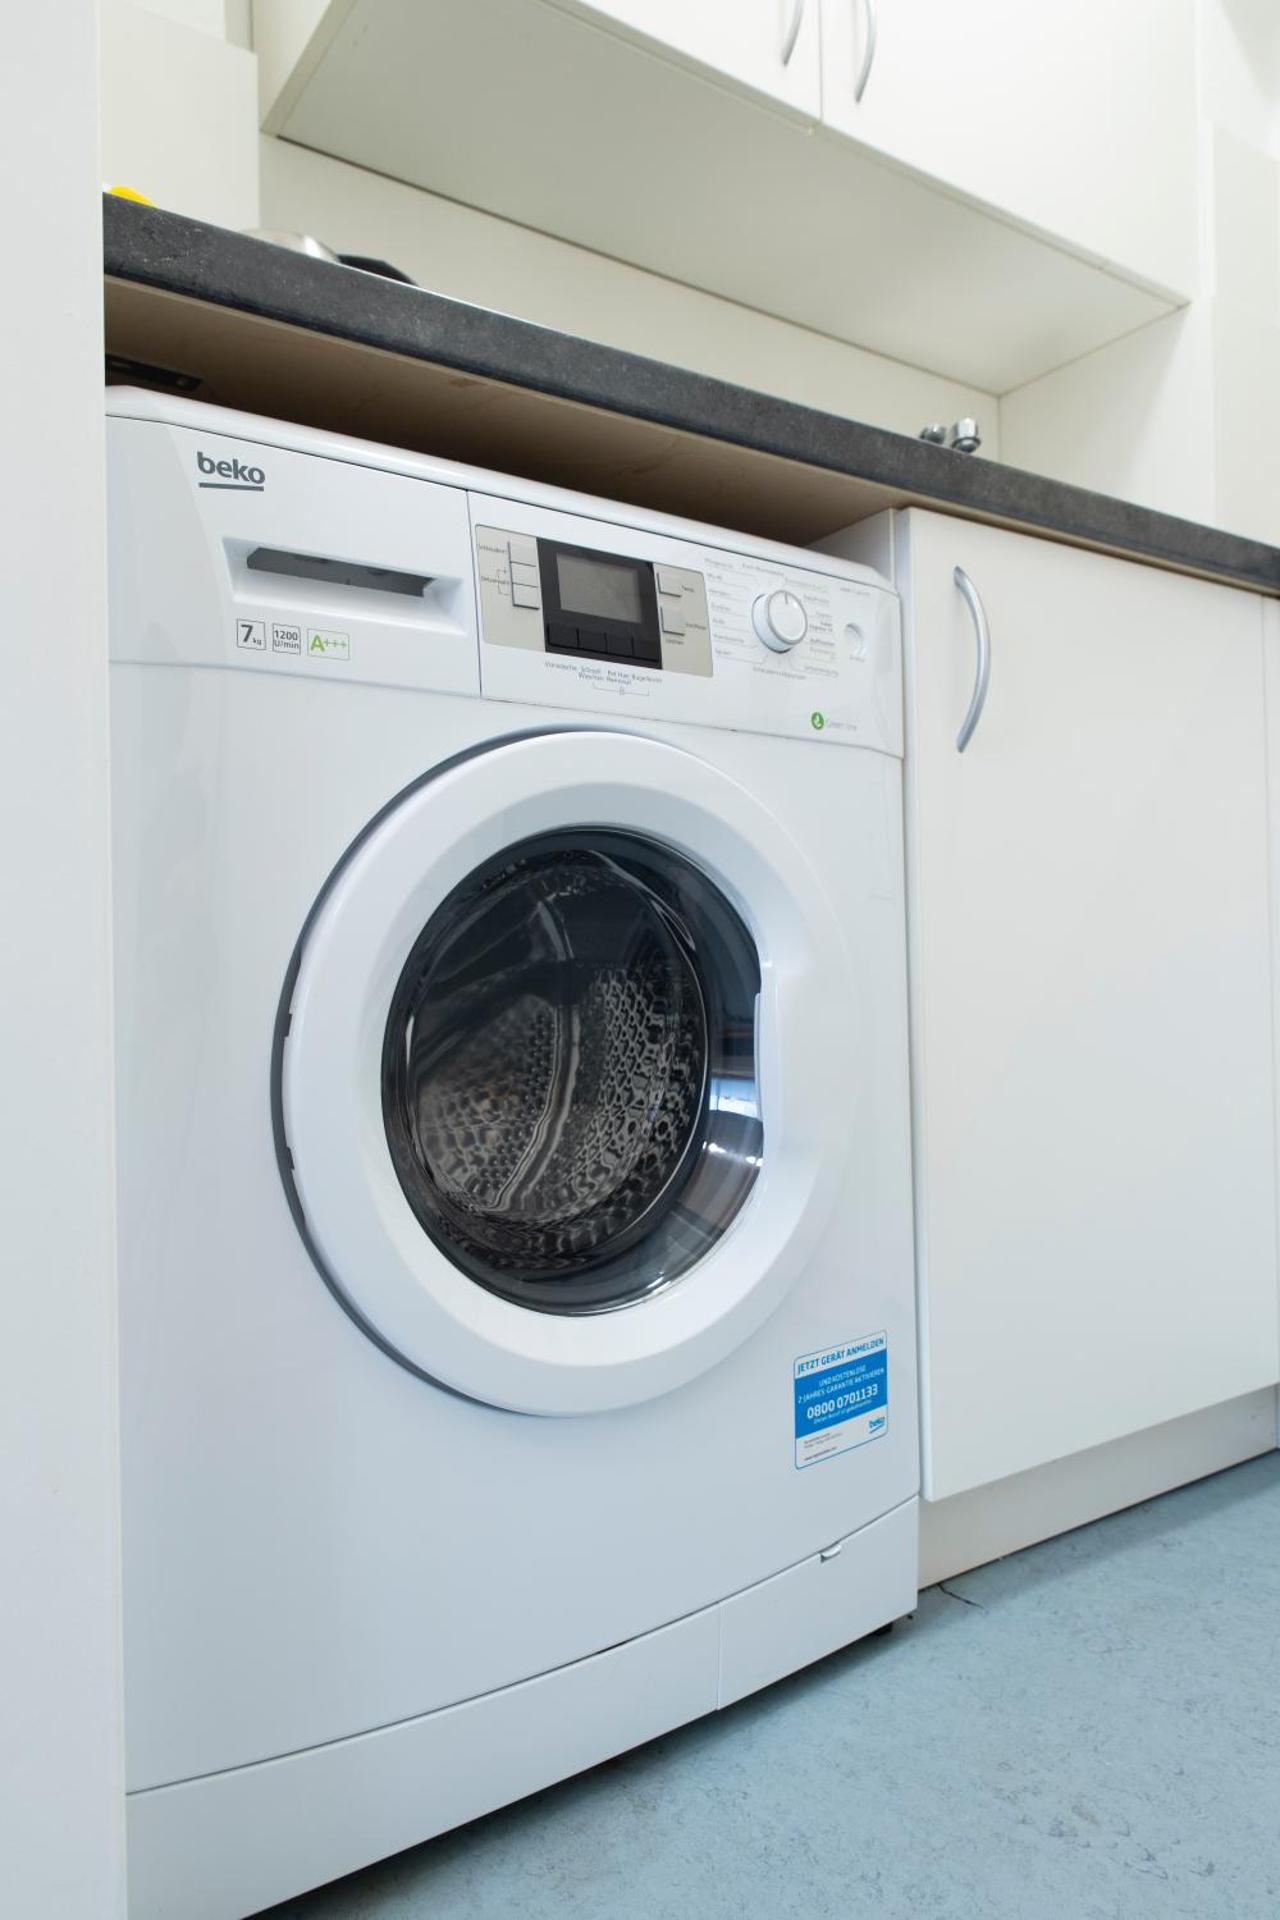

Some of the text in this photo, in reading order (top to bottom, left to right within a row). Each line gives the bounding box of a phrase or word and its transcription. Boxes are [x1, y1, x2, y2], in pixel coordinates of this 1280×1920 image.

[197, 451, 266, 484] beko
[241, 624, 253, 643] 7
[274, 630, 298, 641] 1200
[310, 634, 347, 652] A+++
[797, 1358, 820, 1375] JETZT
[846, 1337, 884, 1356] ANMELDEN
[807, 1400, 835, 1419] 0800
[836, 1384, 878, 1408] 0701133
